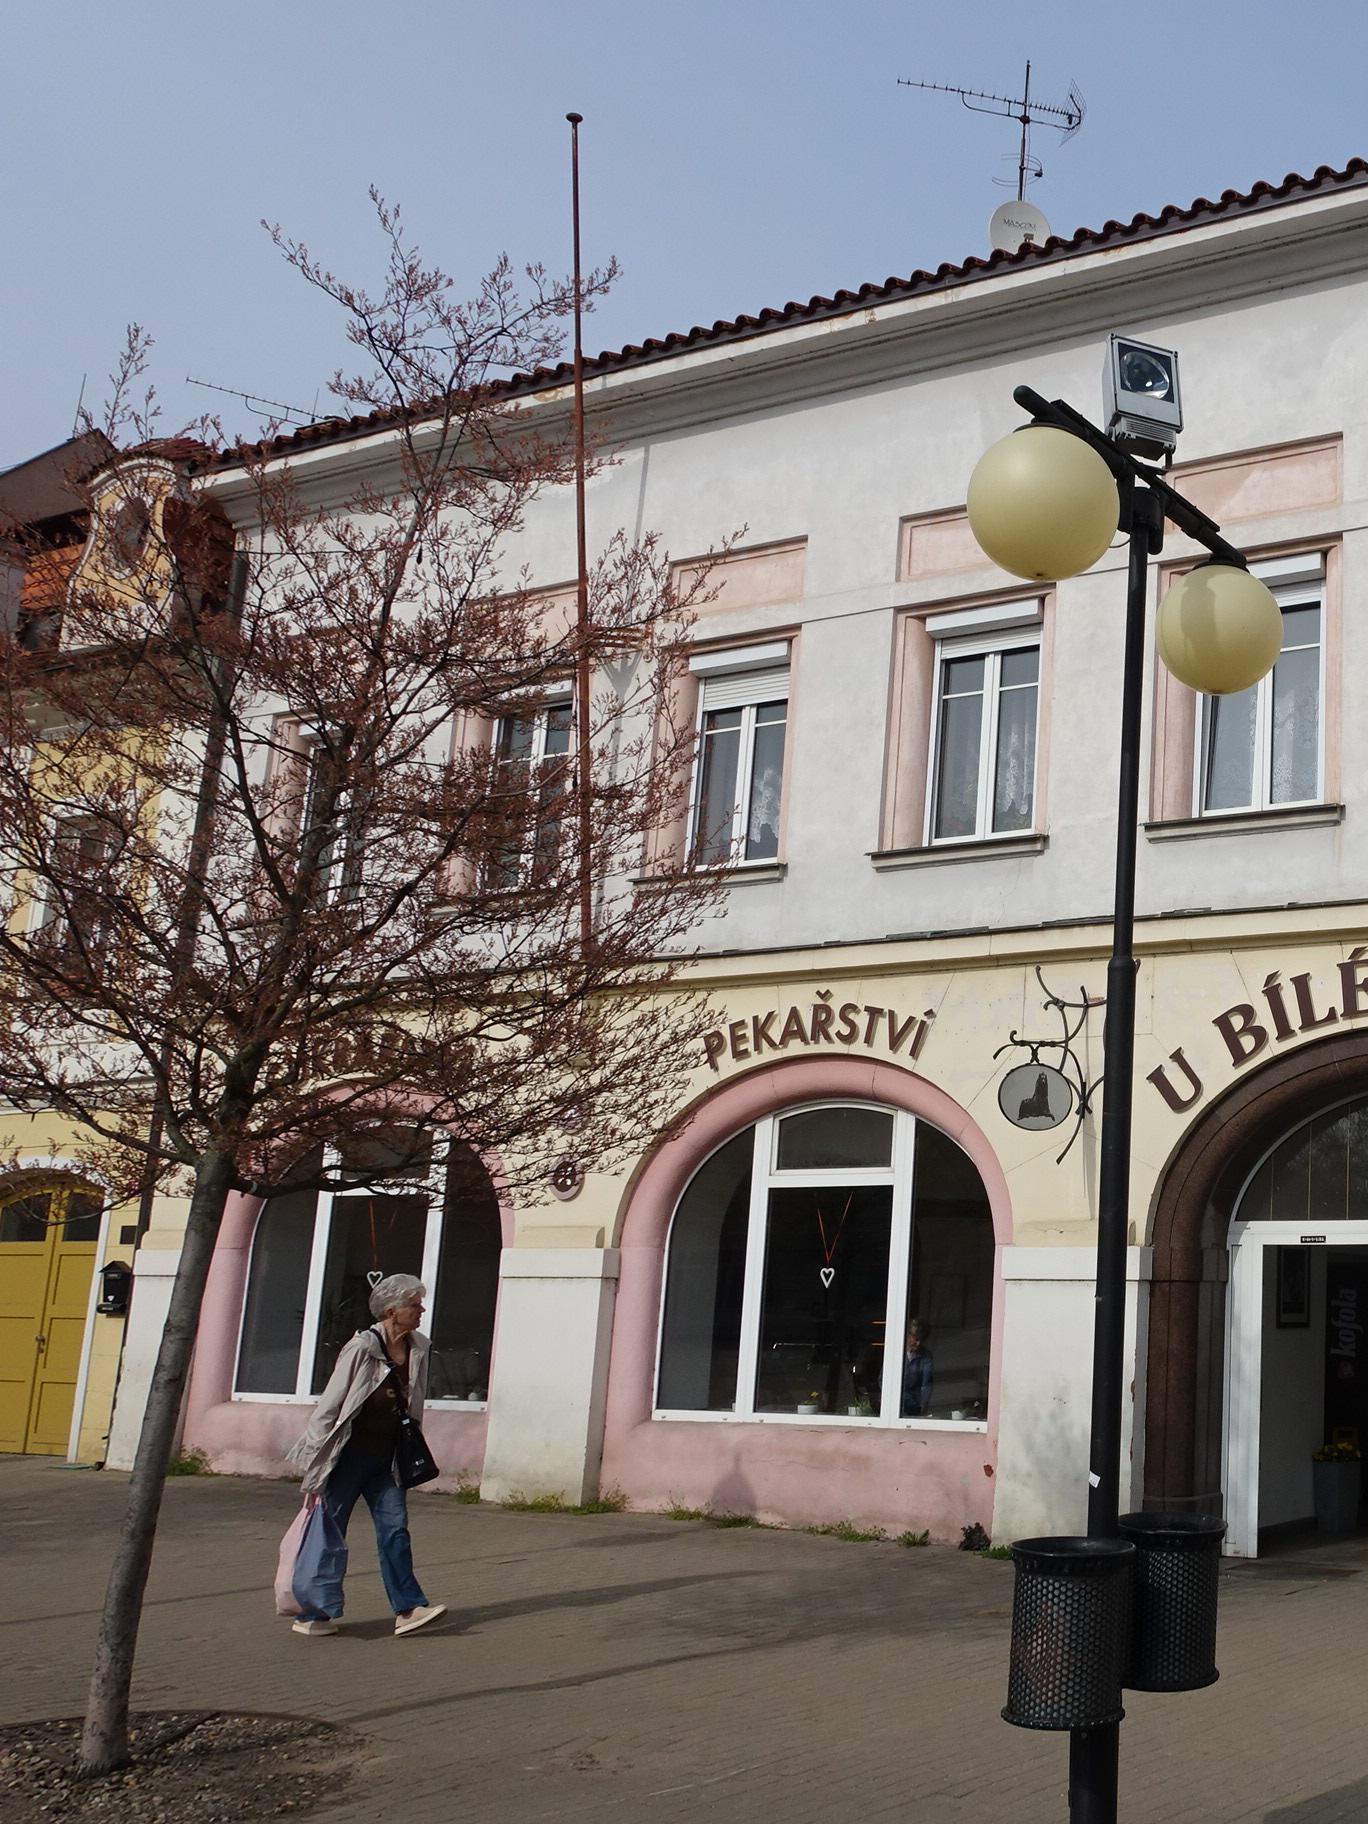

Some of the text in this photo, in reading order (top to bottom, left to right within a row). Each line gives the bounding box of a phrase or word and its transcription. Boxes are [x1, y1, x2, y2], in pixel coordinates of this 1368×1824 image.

[702, 989, 935, 1071] PEKAŘSTVÍ
[1146, 1046, 1204, 1113] U
[1330, 1288, 1365, 1358] kofola
